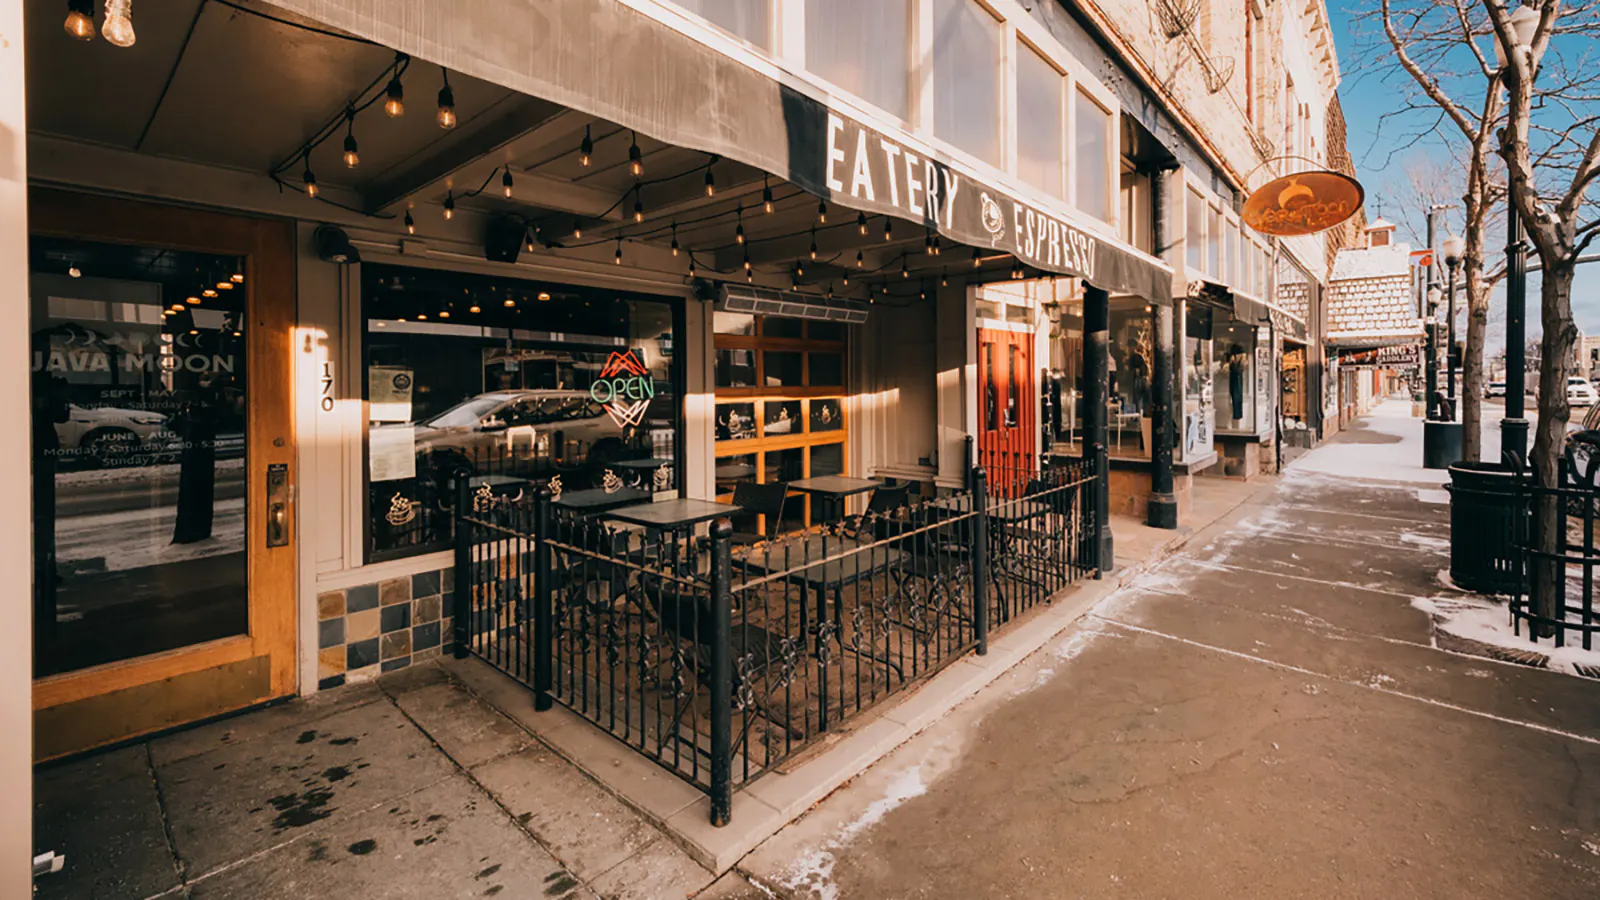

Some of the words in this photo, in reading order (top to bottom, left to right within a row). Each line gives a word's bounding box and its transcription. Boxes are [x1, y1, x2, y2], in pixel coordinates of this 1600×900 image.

[826, 113, 958, 230] EATERY
[1013, 202, 1096, 280] ESPRESSO
[1377, 344, 1416, 356] KING'S
[32, 351, 112, 372] JAVA
[125, 354, 234, 373] MOON
[100, 389, 135, 398] SEPT
[149, 389, 177, 397] MAY
[321, 363, 334, 412] 170
[590, 376, 654, 403] OPEN
[99, 433, 135, 441] JUNE
[149, 431, 177, 440] AUG
[43, 447, 99, 457] Monday
[109, 442, 167, 453] Saturday
[102, 456, 149, 467] Sunday
[168, 455, 176, 463] 2
